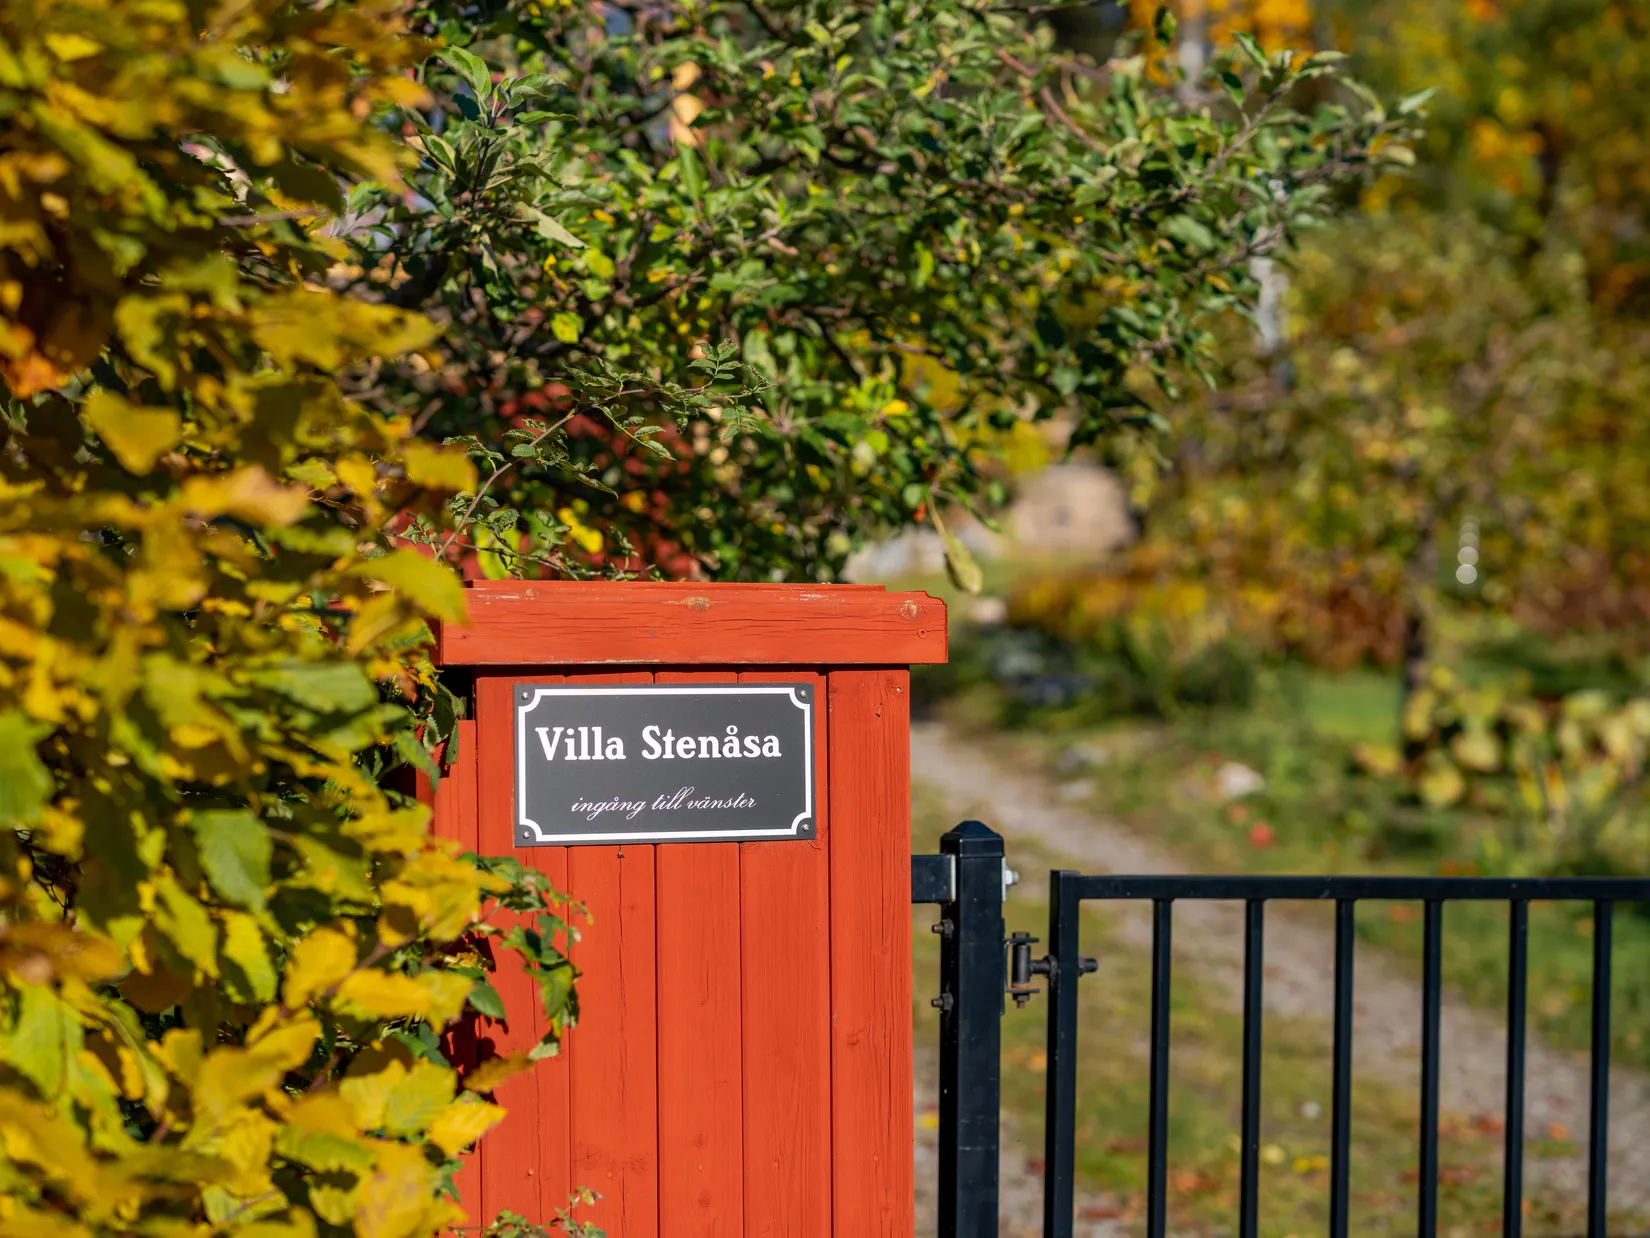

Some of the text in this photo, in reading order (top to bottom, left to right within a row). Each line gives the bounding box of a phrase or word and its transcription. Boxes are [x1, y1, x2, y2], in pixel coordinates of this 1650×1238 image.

[535, 724, 782, 761] Villa Stenåsa
[571, 786, 757, 821] ingång till vänster
